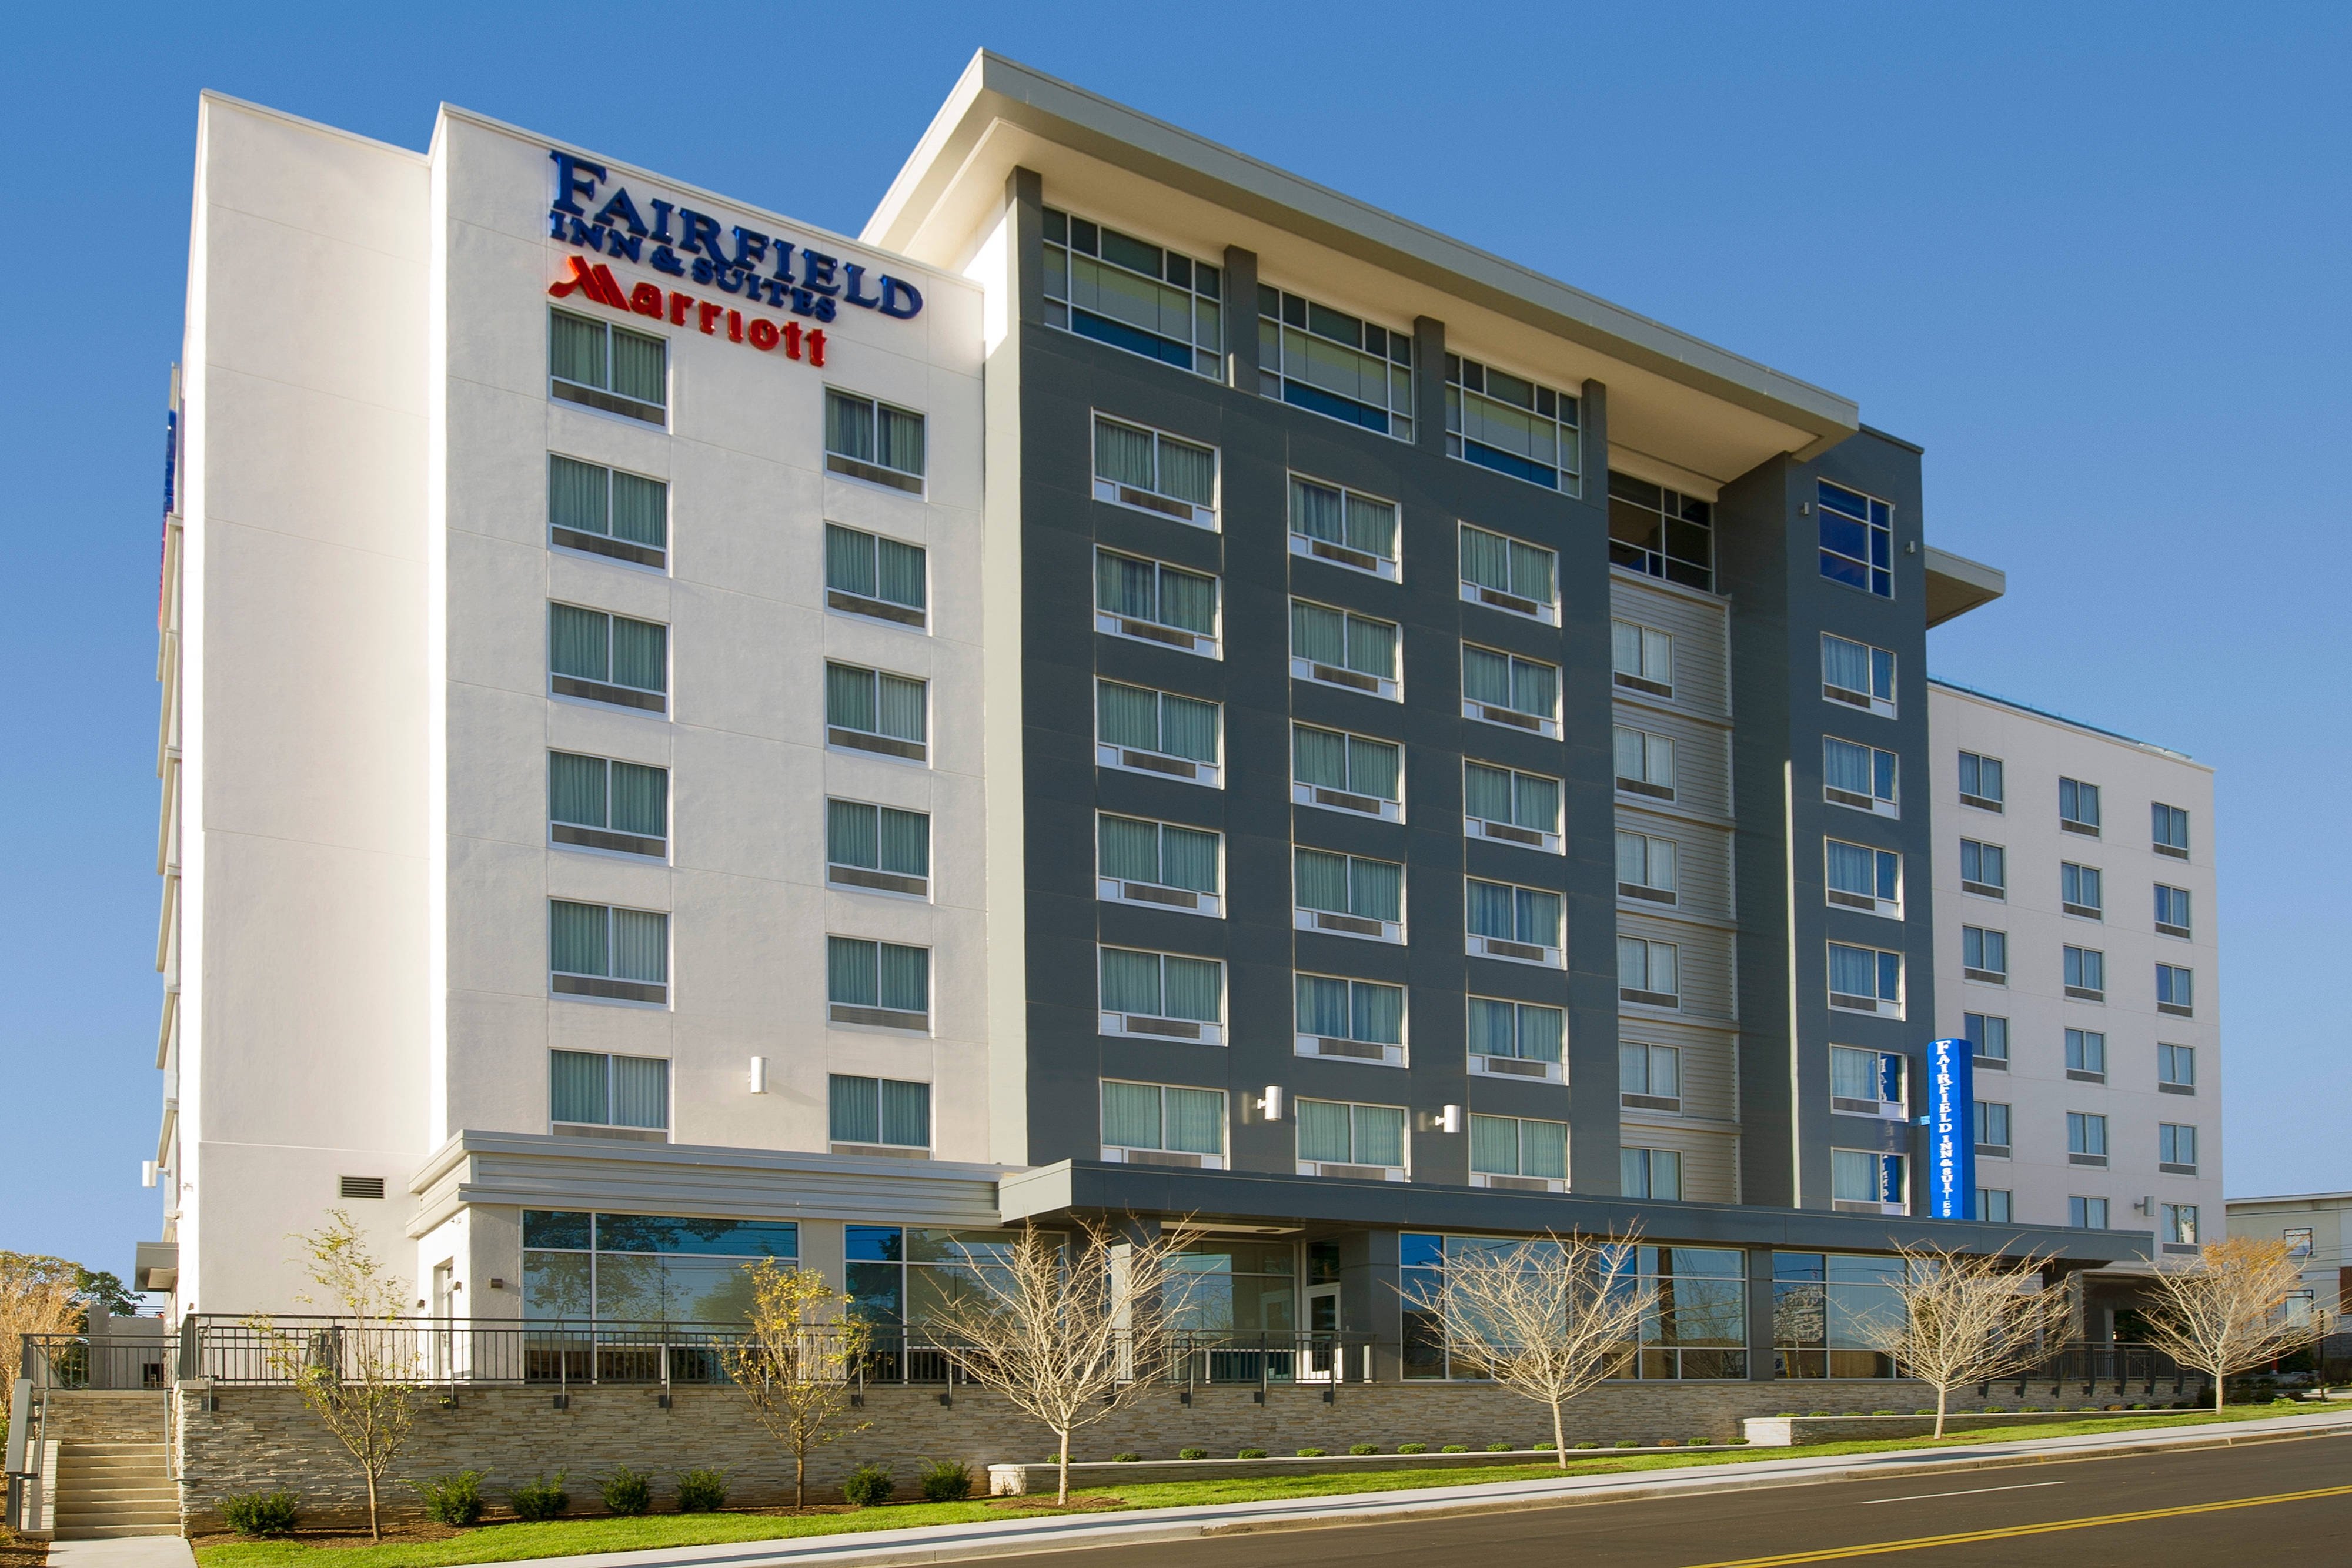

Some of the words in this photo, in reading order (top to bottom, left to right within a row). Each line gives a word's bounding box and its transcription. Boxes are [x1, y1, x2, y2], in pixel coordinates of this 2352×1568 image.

[549, 210, 643, 263] INN
[652, 245, 686, 276] &
[691, 256, 837, 323] SUITES
[550, 149, 923, 320] FAIRFIELD
[549, 255, 826, 367] Marriott
[1936, 1040, 1953, 1133] FAIRFIELD
[1940, 1135, 1953, 1158] INN
[1940, 1158, 1953, 1167] &
[1942, 1168, 1953, 1217] SUITES
